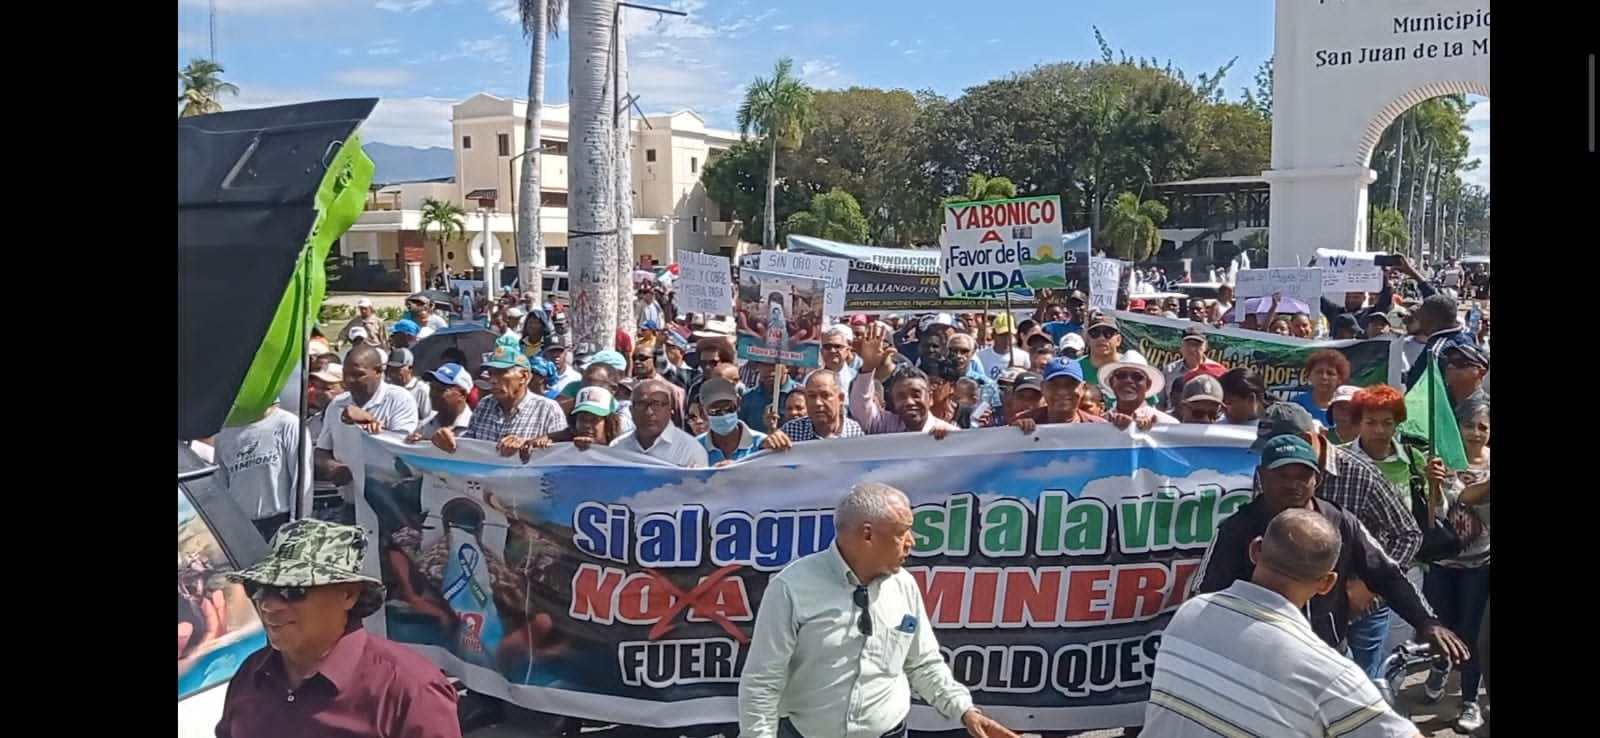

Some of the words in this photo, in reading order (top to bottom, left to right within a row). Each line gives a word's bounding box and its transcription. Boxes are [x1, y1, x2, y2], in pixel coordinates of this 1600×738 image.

[1316, 49, 1351, 67] San
[1358, 45, 1406, 63] Juan
[1413, 43, 1438, 59] de
[1444, 40, 1463, 58] La
[1472, 38, 1489, 56] M
[950, 200, 1055, 230] YABONICO
[980, 230, 1003, 243] A
[767, 254, 786, 268] SIN
[818, 259, 835, 272] SE
[872, 255, 937, 266] FUNDACION
[950, 244, 993, 267] Favor
[847, 283, 916, 293] TRABAJANDO
[918, 286, 938, 294] JUN
[957, 269, 1027, 291] VIDA
[1264, 364, 1294, 388] por
[574, 502, 630, 563] Si
[636, 505, 702, 566] al
[711, 510, 837, 571] agu
[911, 493, 973, 556] si
[979, 500, 1030, 557] a
[1036, 490, 1110, 556] la
[570, 564, 677, 625] NO
[686, 576, 753, 621] A
[912, 562, 1200, 628] MINERI
[944, 645, 1048, 692] OLD
[1052, 632, 1162, 697] QUES
